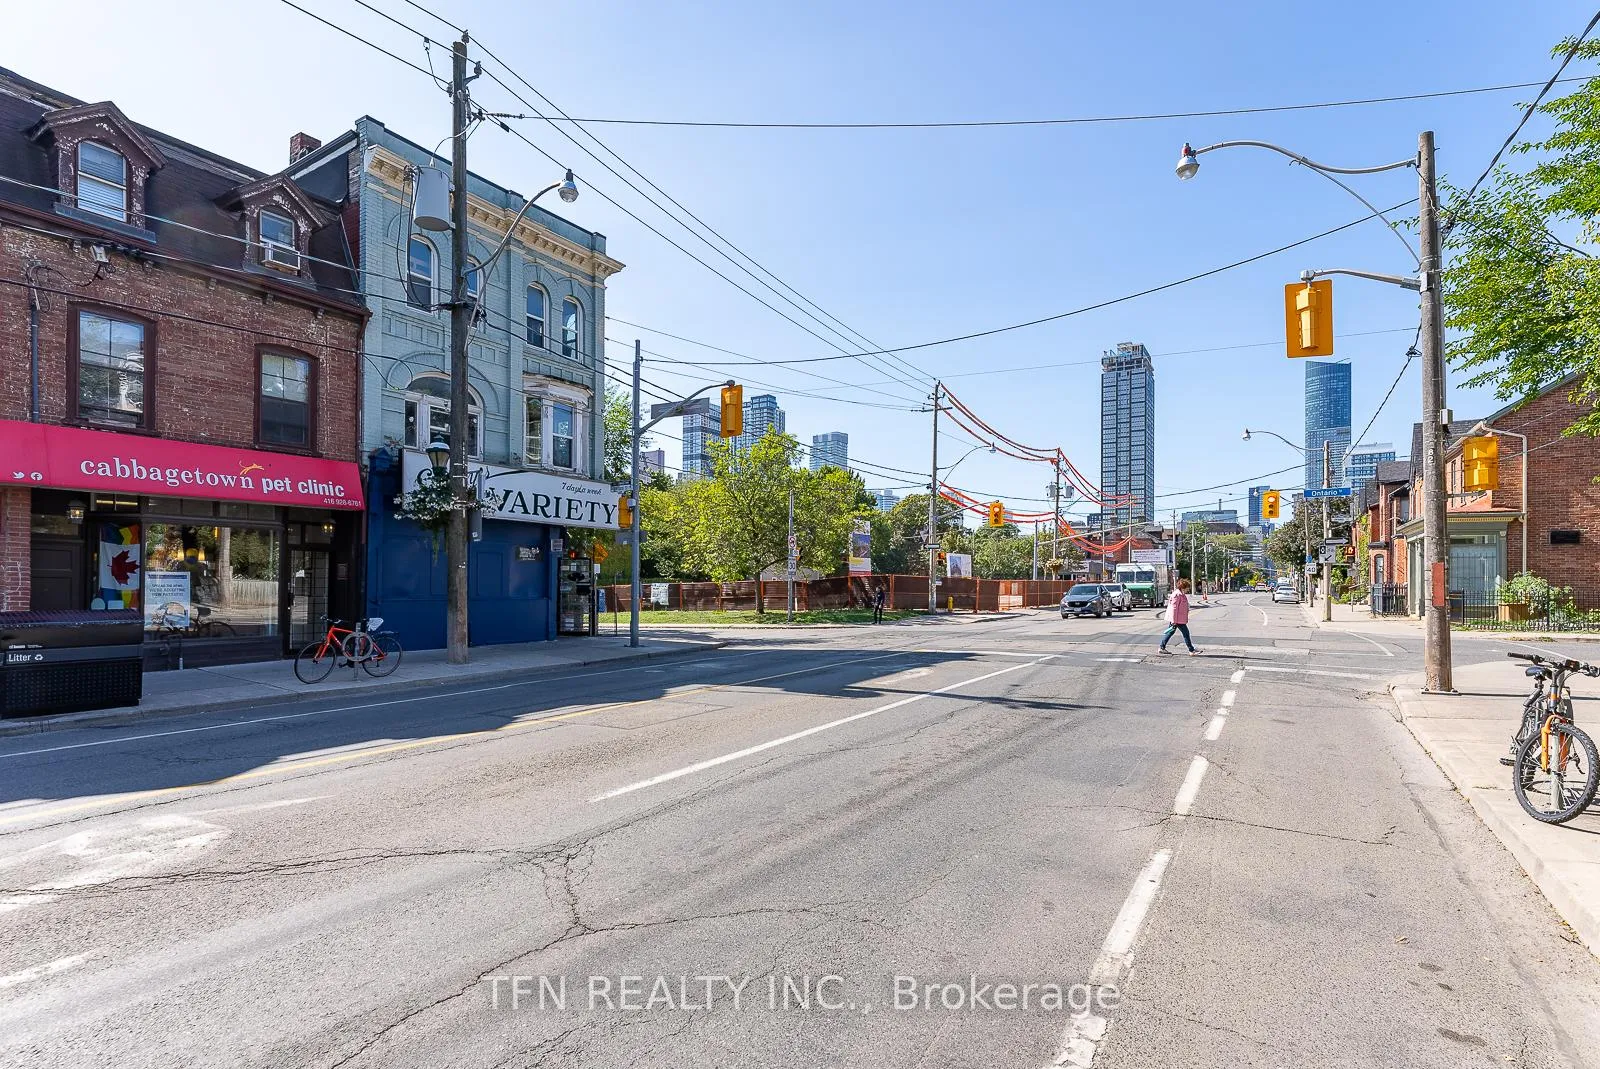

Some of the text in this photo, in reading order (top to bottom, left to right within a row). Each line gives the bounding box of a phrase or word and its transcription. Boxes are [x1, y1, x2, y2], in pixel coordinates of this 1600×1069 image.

[80, 457, 345, 497] cabbagetown pet clinic
[489, 487, 618, 524] VARIETY
[8, 653, 31, 662] Litter
